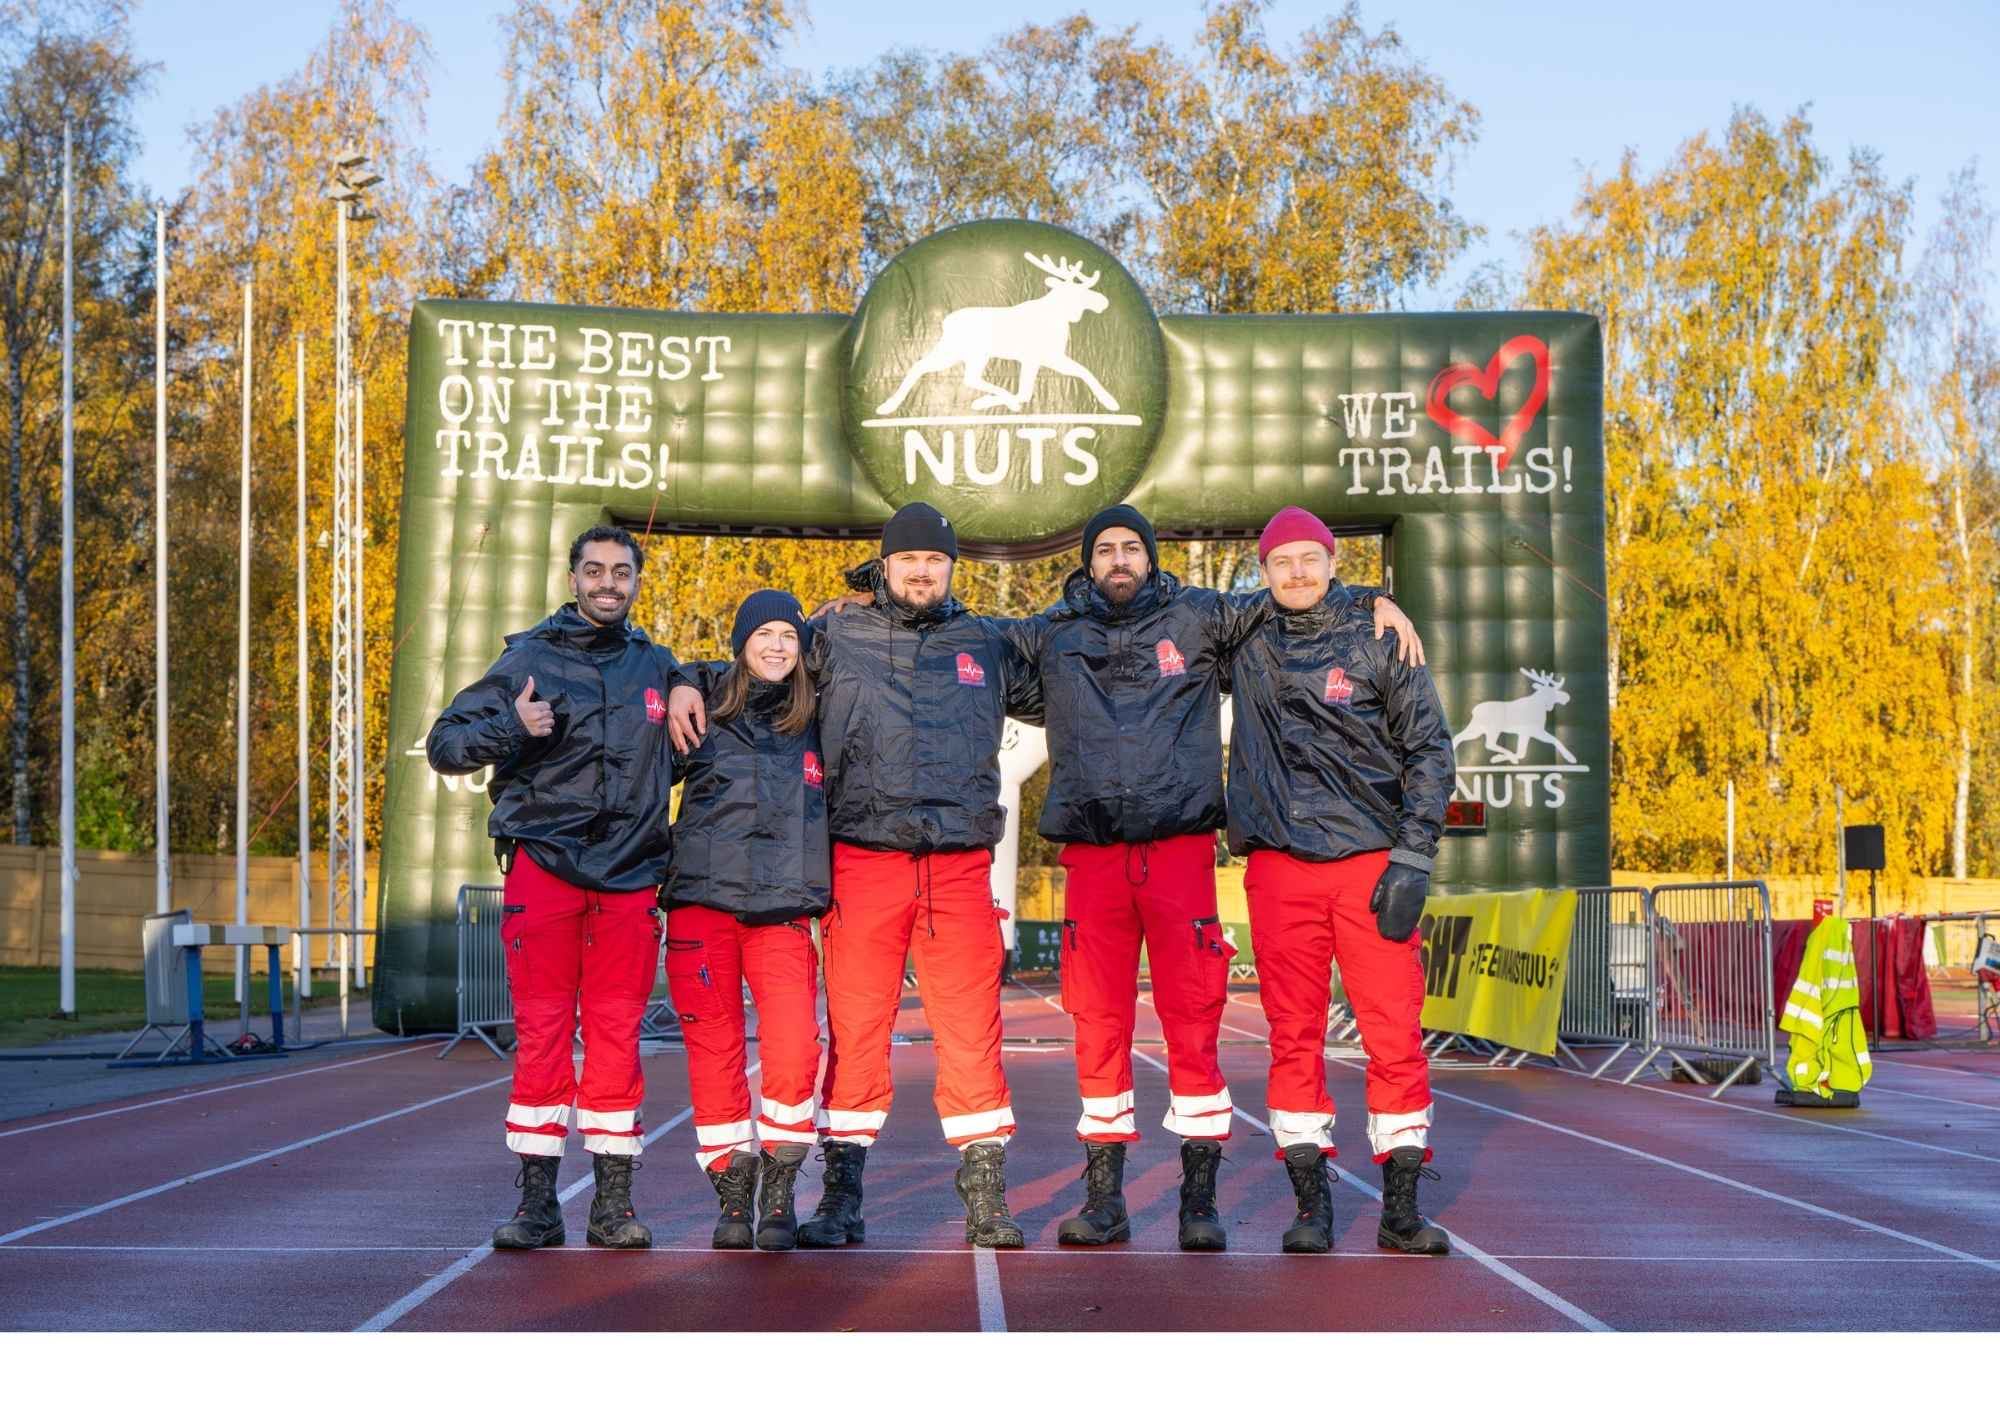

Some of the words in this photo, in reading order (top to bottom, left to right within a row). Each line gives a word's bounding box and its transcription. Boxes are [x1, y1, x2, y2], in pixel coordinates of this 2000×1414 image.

[437, 318, 556, 370] THE
[578, 327, 732, 382] BEST
[437, 374, 515, 425] ON
[535, 377, 653, 433] THE
[1337, 391, 1417, 440] WE
[436, 429, 670, 492] TRAILS!
[903, 426, 1099, 486] NUTS
[1338, 445, 1573, 496] TRAILS!
[427, 763, 495, 794] NU
[1450, 772, 1566, 809] NUTS
